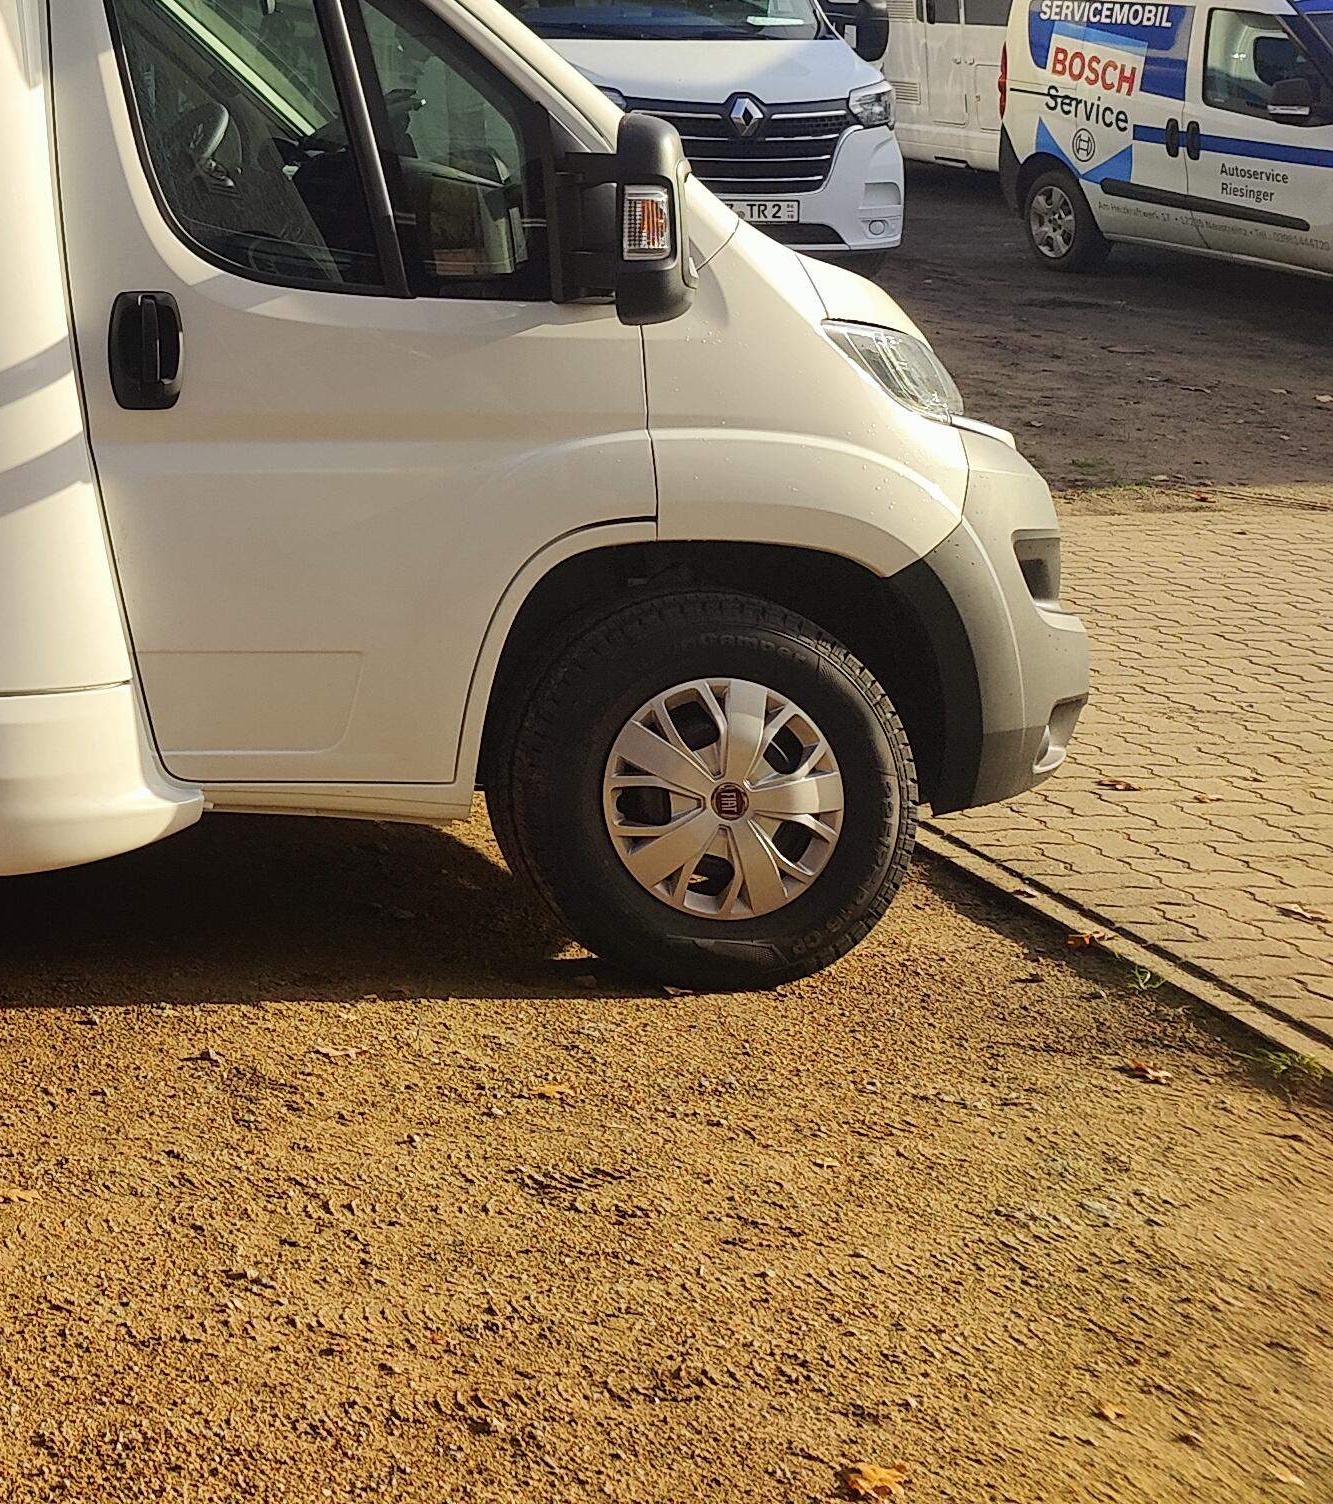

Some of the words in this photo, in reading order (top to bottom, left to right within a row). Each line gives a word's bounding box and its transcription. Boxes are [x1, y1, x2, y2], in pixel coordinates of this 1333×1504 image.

[1039, 0, 1173, 28] SERVICEMOBIL
[1050, 46, 1138, 97] BOSCH
[1044, 84, 1130, 133] Service
[1219, 162, 1289, 184] Autoservice
[1220, 182, 1275, 204] Riesinger
[746, 203, 768, 219] TR
[771, 203, 782, 219] 2
[720, 792, 738, 813] FIAT
